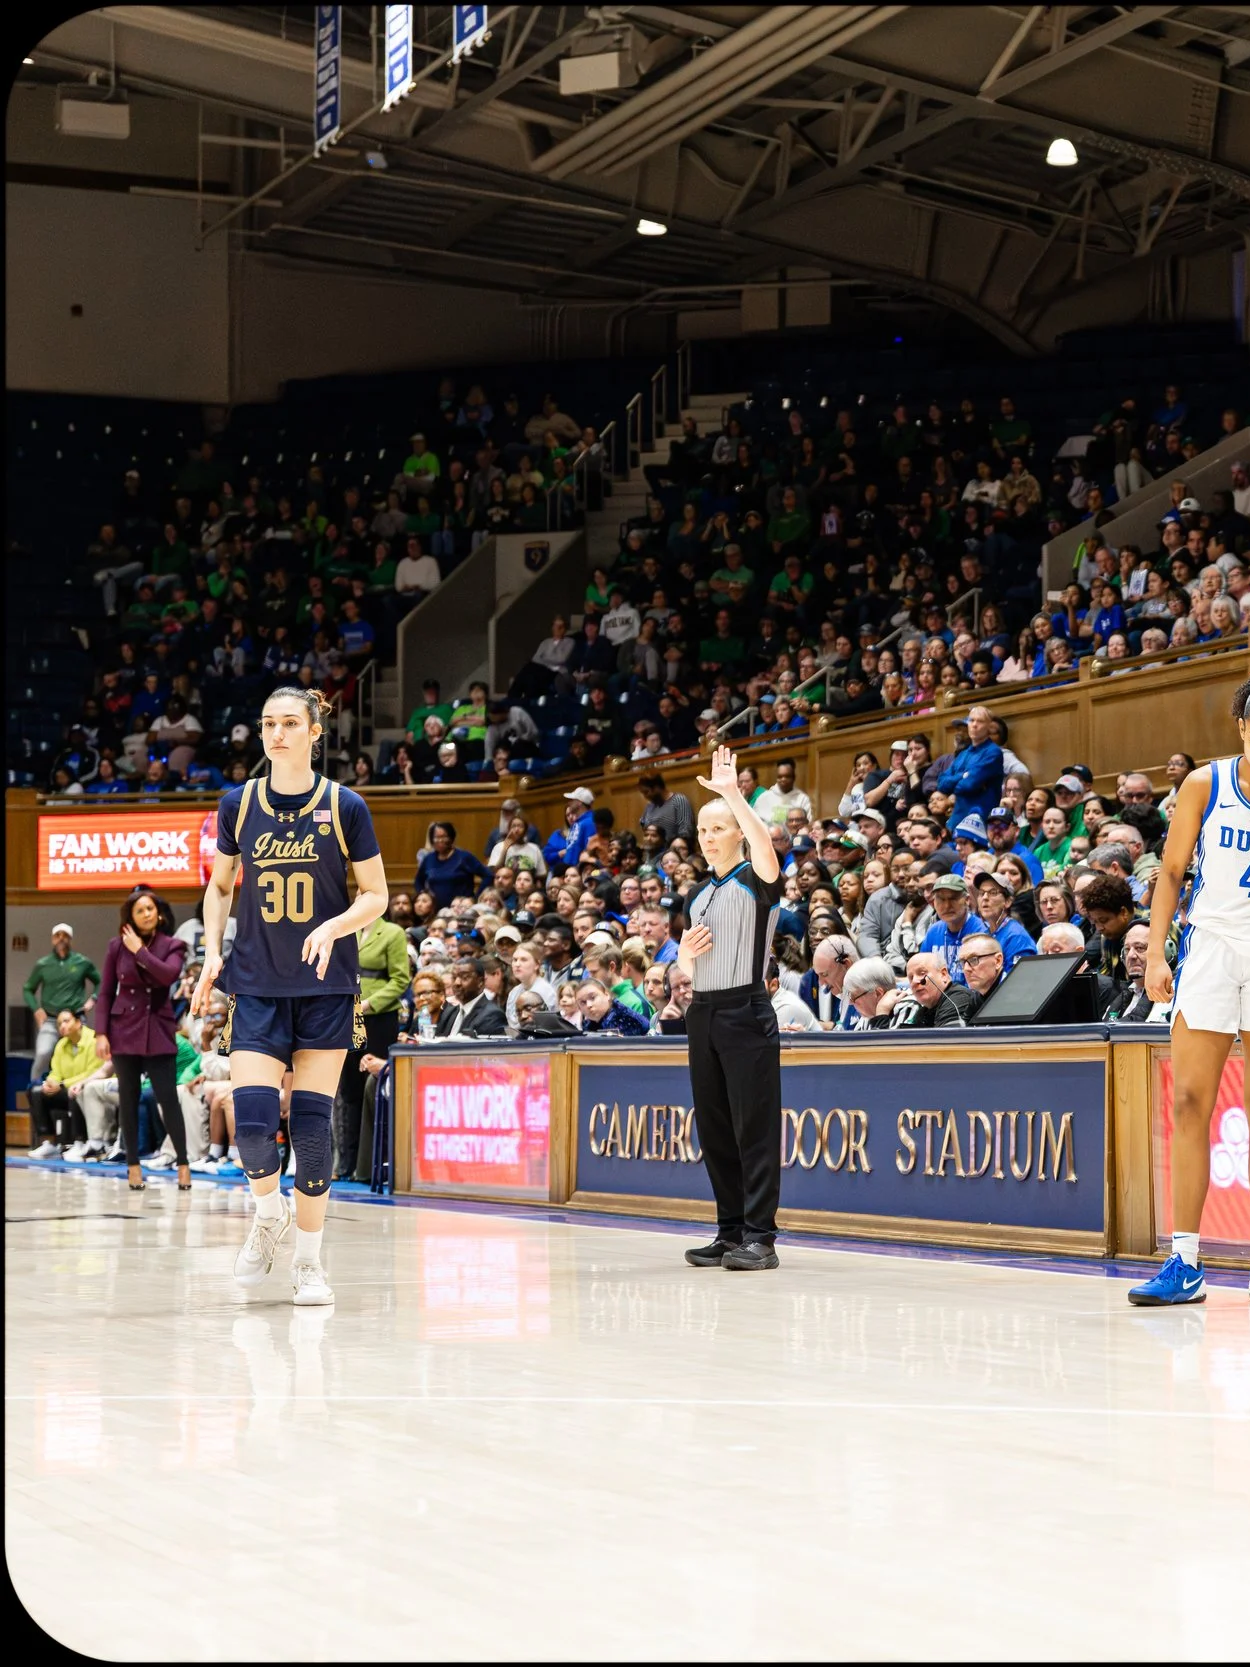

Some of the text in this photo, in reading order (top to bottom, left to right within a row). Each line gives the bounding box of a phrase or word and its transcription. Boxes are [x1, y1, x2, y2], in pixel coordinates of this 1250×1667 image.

[49, 833, 101, 857] FAN
[105, 831, 190, 856] WORK
[251, 830, 320, 869] Irish
[49, 856, 190, 874] IS THIRSTY WORK
[257, 871, 314, 923] 30
[424, 1084, 460, 1128] FAN
[461, 1084, 521, 1130] WORK
[483, 1136, 520, 1165] WORK
[589, 1101, 703, 1164] CAMERO
[780, 1107, 873, 1175] DOOR
[895, 1108, 1079, 1184] STADIUM
